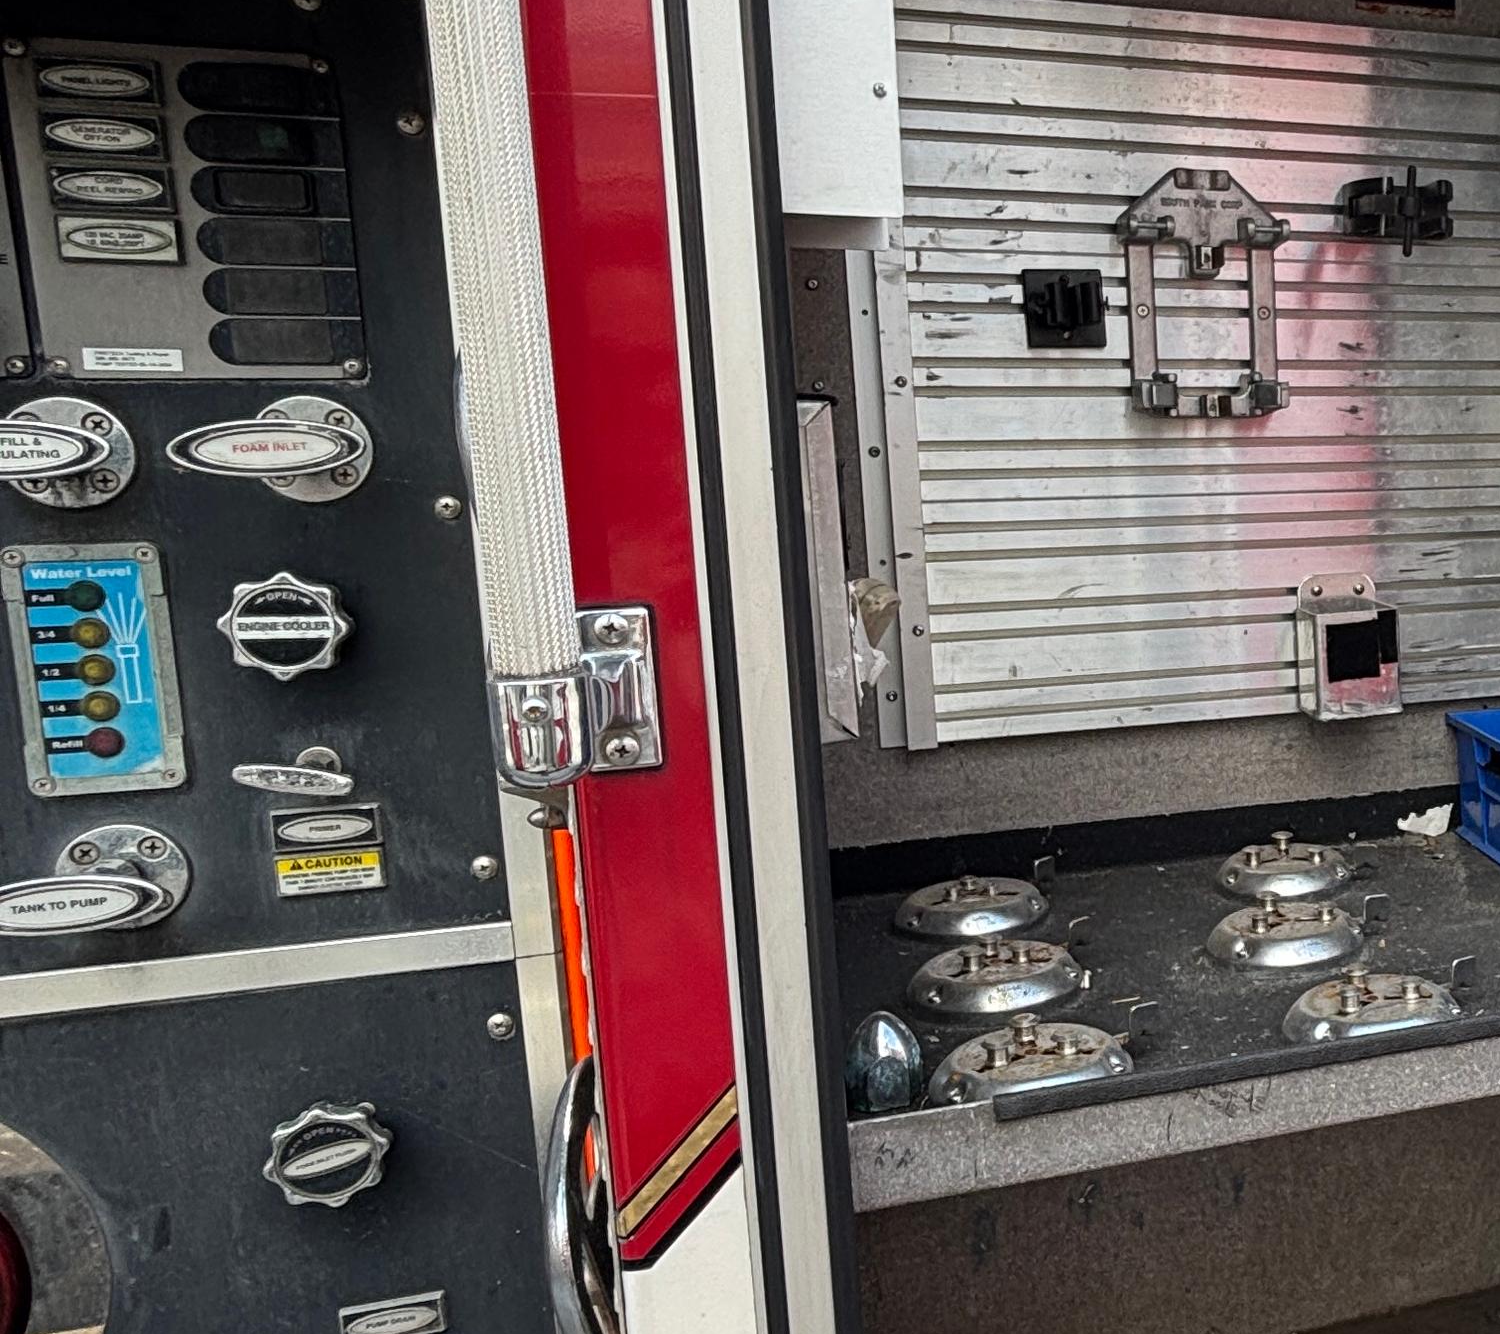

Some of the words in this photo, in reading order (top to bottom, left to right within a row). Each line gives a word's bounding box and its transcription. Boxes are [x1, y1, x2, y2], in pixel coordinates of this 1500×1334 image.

[0, 436, 29, 446] FILL
[32, 436, 42, 446] &
[232, 443, 270, 453] FOAM
[273, 441, 307, 452] INLET
[0, 449, 61, 460] ULATING
[30, 567, 81, 580] Water
[86, 566, 132, 578] Level
[31, 593, 55, 604] Full
[265, 591, 298, 602] OPEN
[237, 621, 281, 632] ENGINE
[282, 620, 330, 632] COOLER
[41, 668, 61, 677] 1/2
[52, 739, 84, 750] Refill
[305, 855, 363, 870] CAUTION
[10, 902, 46, 915] TANK
[48, 900, 67, 911] TO
[69, 896, 108, 908] PUMP
[303, 1126, 335, 1141] OPEN
[365, 1318, 389, 1330] PUMP
